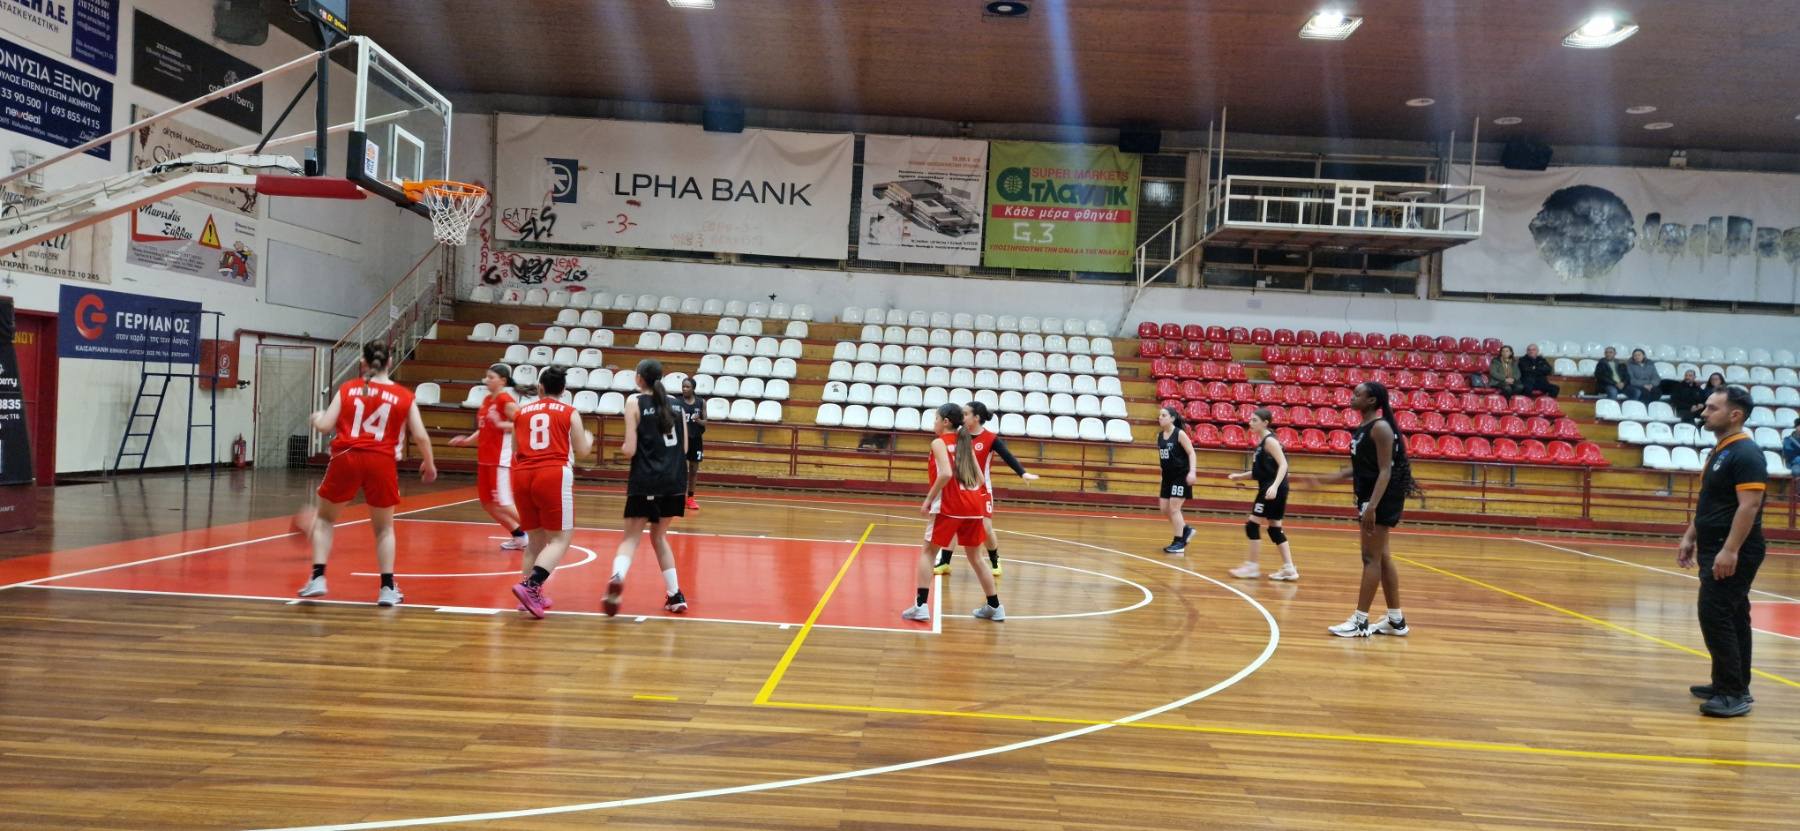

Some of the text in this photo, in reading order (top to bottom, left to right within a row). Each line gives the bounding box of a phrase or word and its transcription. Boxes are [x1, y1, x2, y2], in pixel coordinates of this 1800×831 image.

[54, 69, 100, 101] ΞΕΝΟΥ
[51, 105, 66, 118] 693
[1031, 168, 1129, 181] SUPER MARKETS
[711, 178, 812, 207] BANK
[1004, 206, 1119, 221] Κάθε μέρα φθηνά!
[115, 311, 190, 334] ΓΕΡΜΑΝΟΣ
[351, 397, 392, 441] 14
[529, 412, 550, 451] 8
